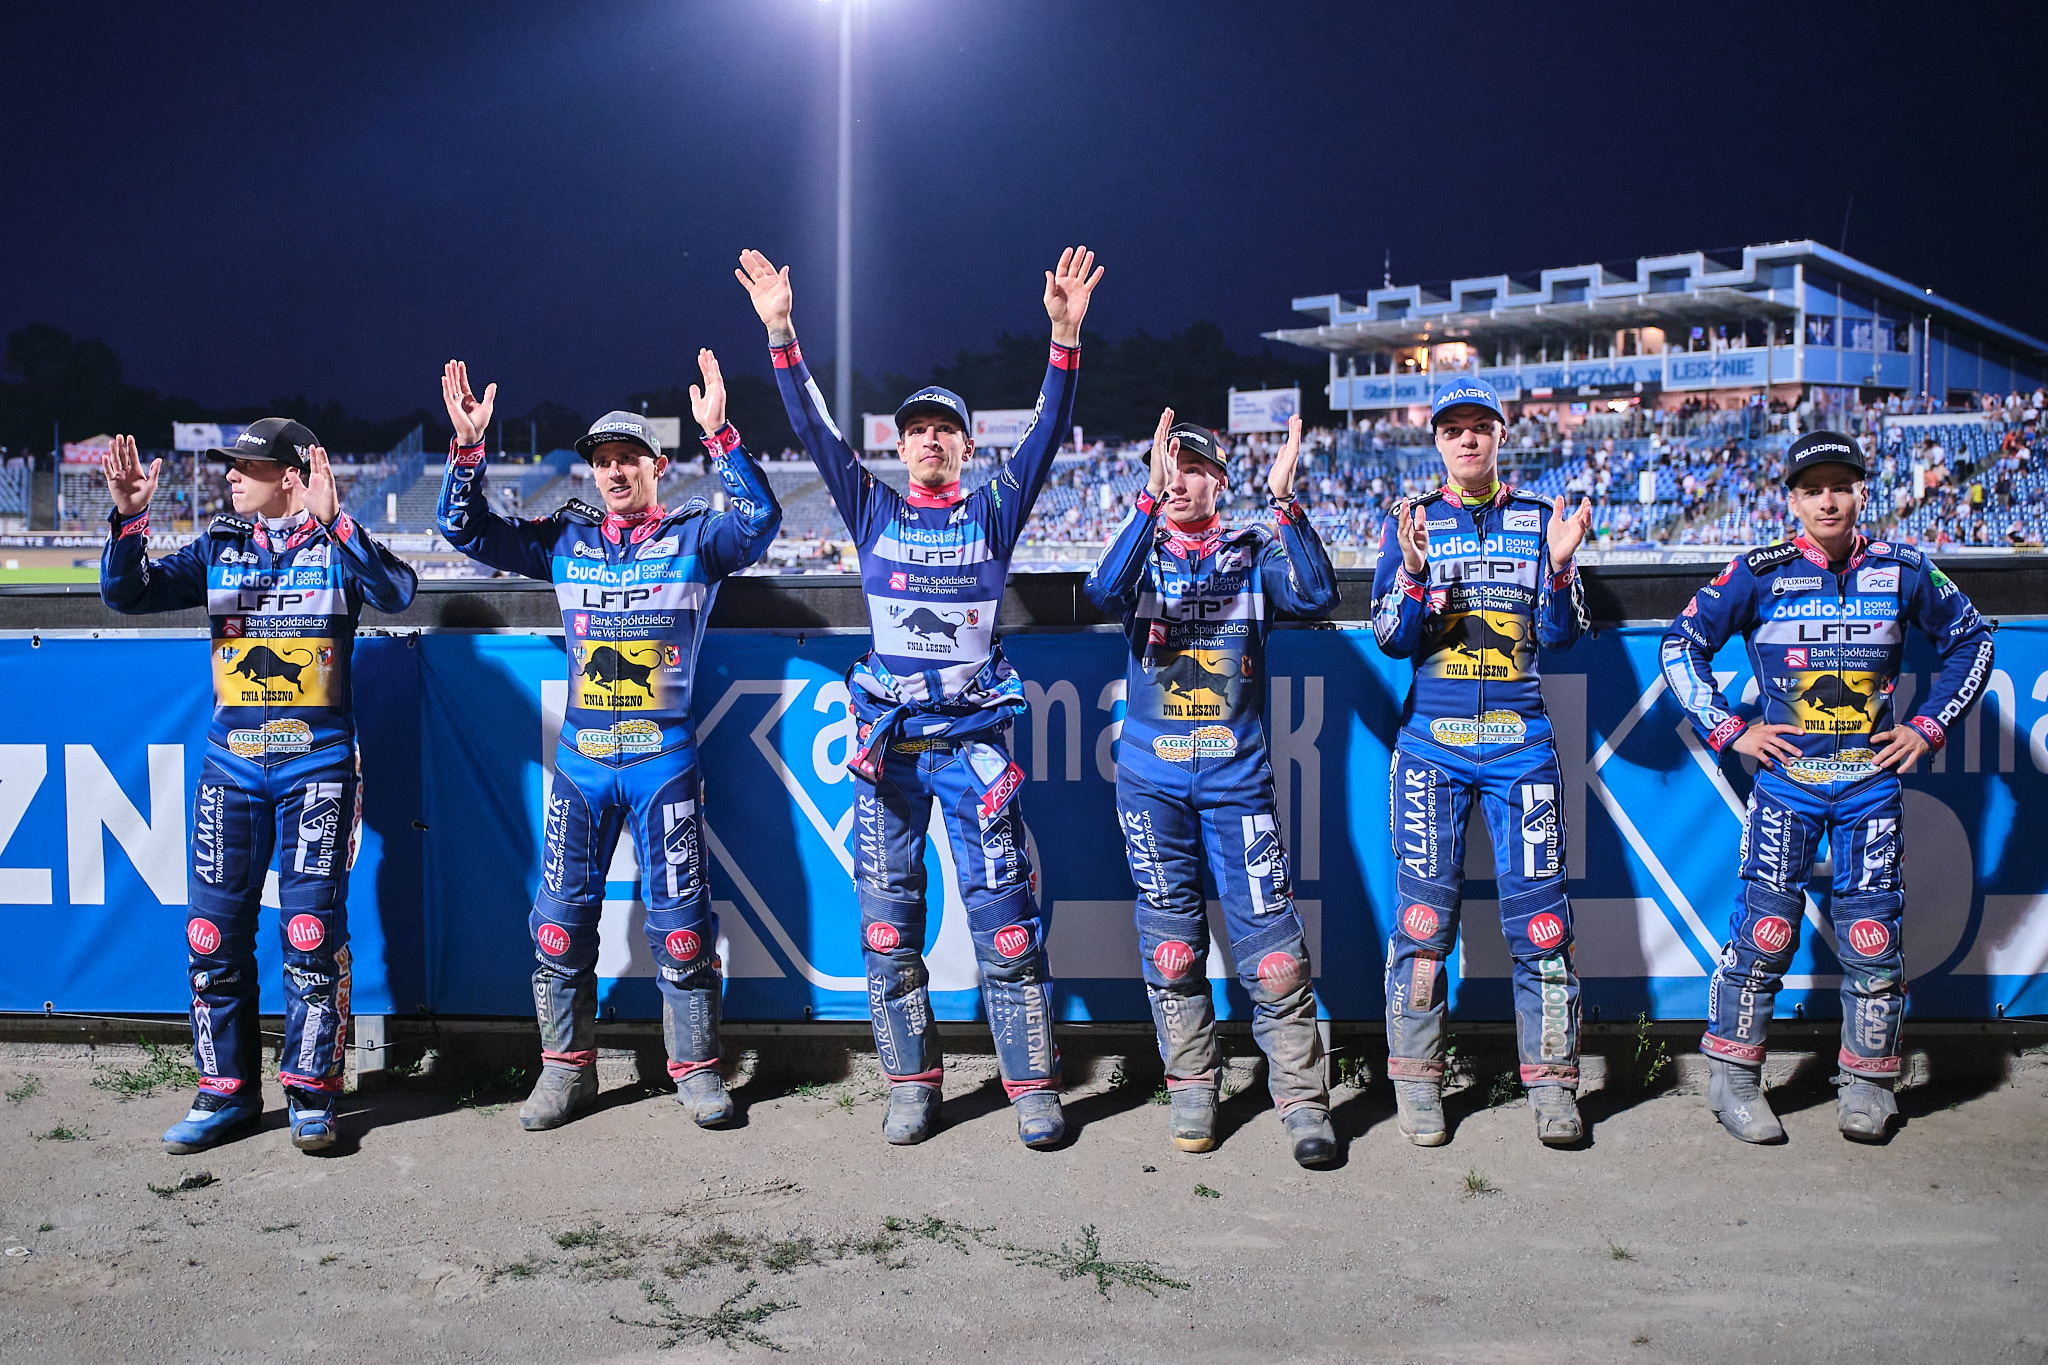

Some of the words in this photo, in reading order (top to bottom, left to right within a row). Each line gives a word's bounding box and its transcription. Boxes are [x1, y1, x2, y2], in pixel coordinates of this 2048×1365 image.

[1673, 357, 1754, 381] LESZNIE
[1794, 443, 1851, 463] POLCOPPER
[1513, 519, 1537, 528] PGE
[1428, 535, 1504, 558] udio.pl
[1505, 538, 1535, 547] DOMY
[1505, 546, 1540, 558] GOTOW
[908, 548, 956, 564] LFP
[1747, 545, 1798, 568] CANAL+
[221, 569, 294, 589] budio.pl
[296, 571, 324, 579] DOMY
[566, 560, 640, 586] budio.pl
[642, 563, 670, 572] DOMY
[642, 570, 682, 579] GOTOWE
[1439, 561, 1515, 583] LFP
[908, 573, 930, 585] Bank
[931, 574, 977, 587] Spółdzielczy
[1782, 577, 1821, 586] FLIXHOME
[1868, 579, 1894, 589] PGE
[908, 586, 920, 594] we
[920, 585, 958, 595] Wschowie
[1452, 587, 1478, 598] Bank
[237, 593, 302, 612] LFP
[583, 588, 650, 609] LFP
[1863, 601, 1892, 609] DOMY
[1453, 602, 1467, 610] we
[245, 617, 267, 628] Bank
[269, 617, 328, 630] Spółdzielczy
[590, 614, 612, 626] Bank
[613, 614, 676, 627] Spółdzielczy
[245, 630, 257, 638] we
[259, 629, 301, 639] Wschowie
[590, 629, 602, 637] we
[602, 627, 649, 638] Wschowie
[1799, 623, 1871, 642] LFP
[907, 641, 924, 652] UNIA
[926, 642, 952, 654] LESZNO
[1810, 647, 1836, 658] Bank
[1837, 647, 1890, 660] Spółdzielczy
[1446, 664, 1468, 676] UNIA
[1937, 640, 1994, 727] POLCOPPER
[241, 690, 258, 702] UNIA
[261, 690, 294, 702] LESZNO
[583, 693, 604, 706] UNIA
[1163, 704, 1183, 717] UNIA
[1186, 704, 1221, 717] LESZNO
[1438, 722, 1519, 734] AGROMIX
[1805, 719, 1826, 731] UNIA
[231, 732, 304, 744] AGROMIX
[580, 733, 654, 744] AGROMIX
[1160, 738, 1230, 749] AGROMIX
[1791, 759, 1875, 773] AGROMIX
[992, 770, 1018, 809] Fogo
[1404, 768, 1427, 878] ALMAR
[1428, 768, 1439, 878] TRANSPORT-SPEDYCJA
[194, 783, 218, 884] ALMAR
[215, 785, 226, 884] TRANSPORT-SPEDYCJA
[543, 792, 563, 893] ALMAR
[1126, 809, 1163, 908] ALMAR
[688, 995, 699, 1023] AUTO
[870, 973, 900, 1070] GARCAREK
[203, 1039, 217, 1074] EXPERT
[1720, 1043, 1757, 1059] Fogo
[1734, 1105, 1754, 1125] JCR
